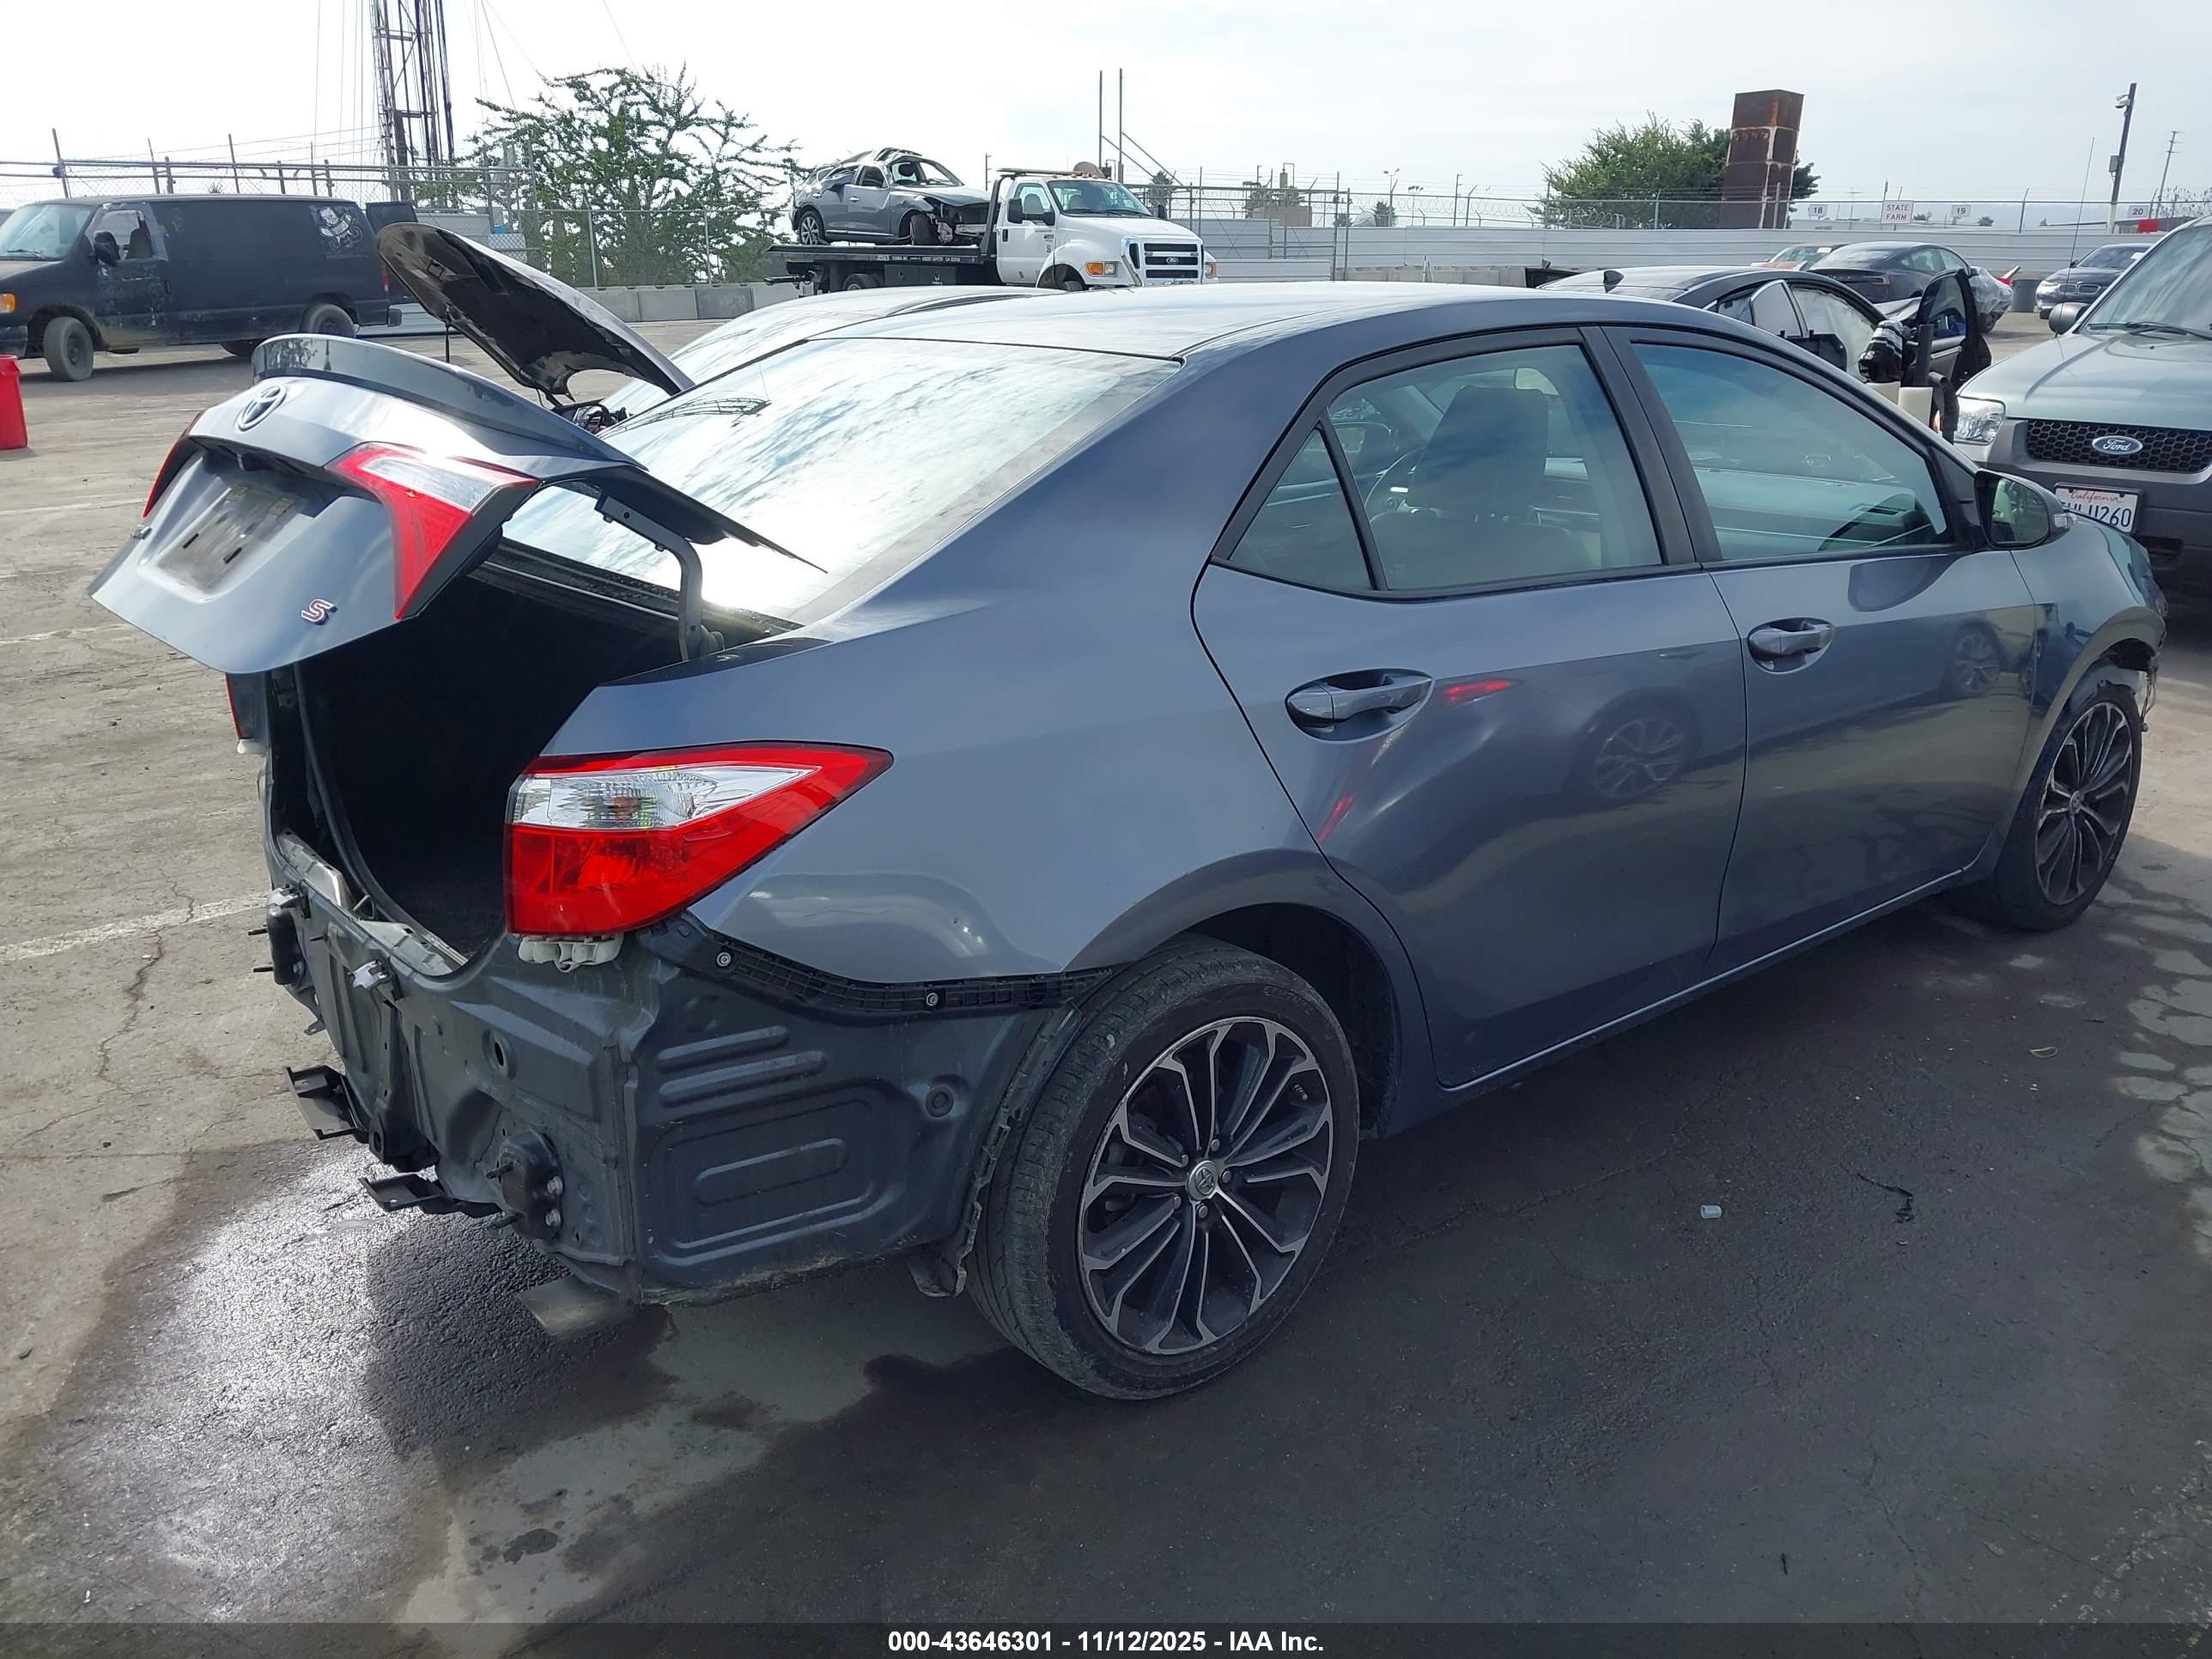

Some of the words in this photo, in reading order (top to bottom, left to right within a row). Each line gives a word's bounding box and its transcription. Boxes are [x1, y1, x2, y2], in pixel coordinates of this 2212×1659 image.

[2103, 439, 2131, 452] Ford
[2070, 489, 2124, 503] California
[301, 599, 335, 623] S
